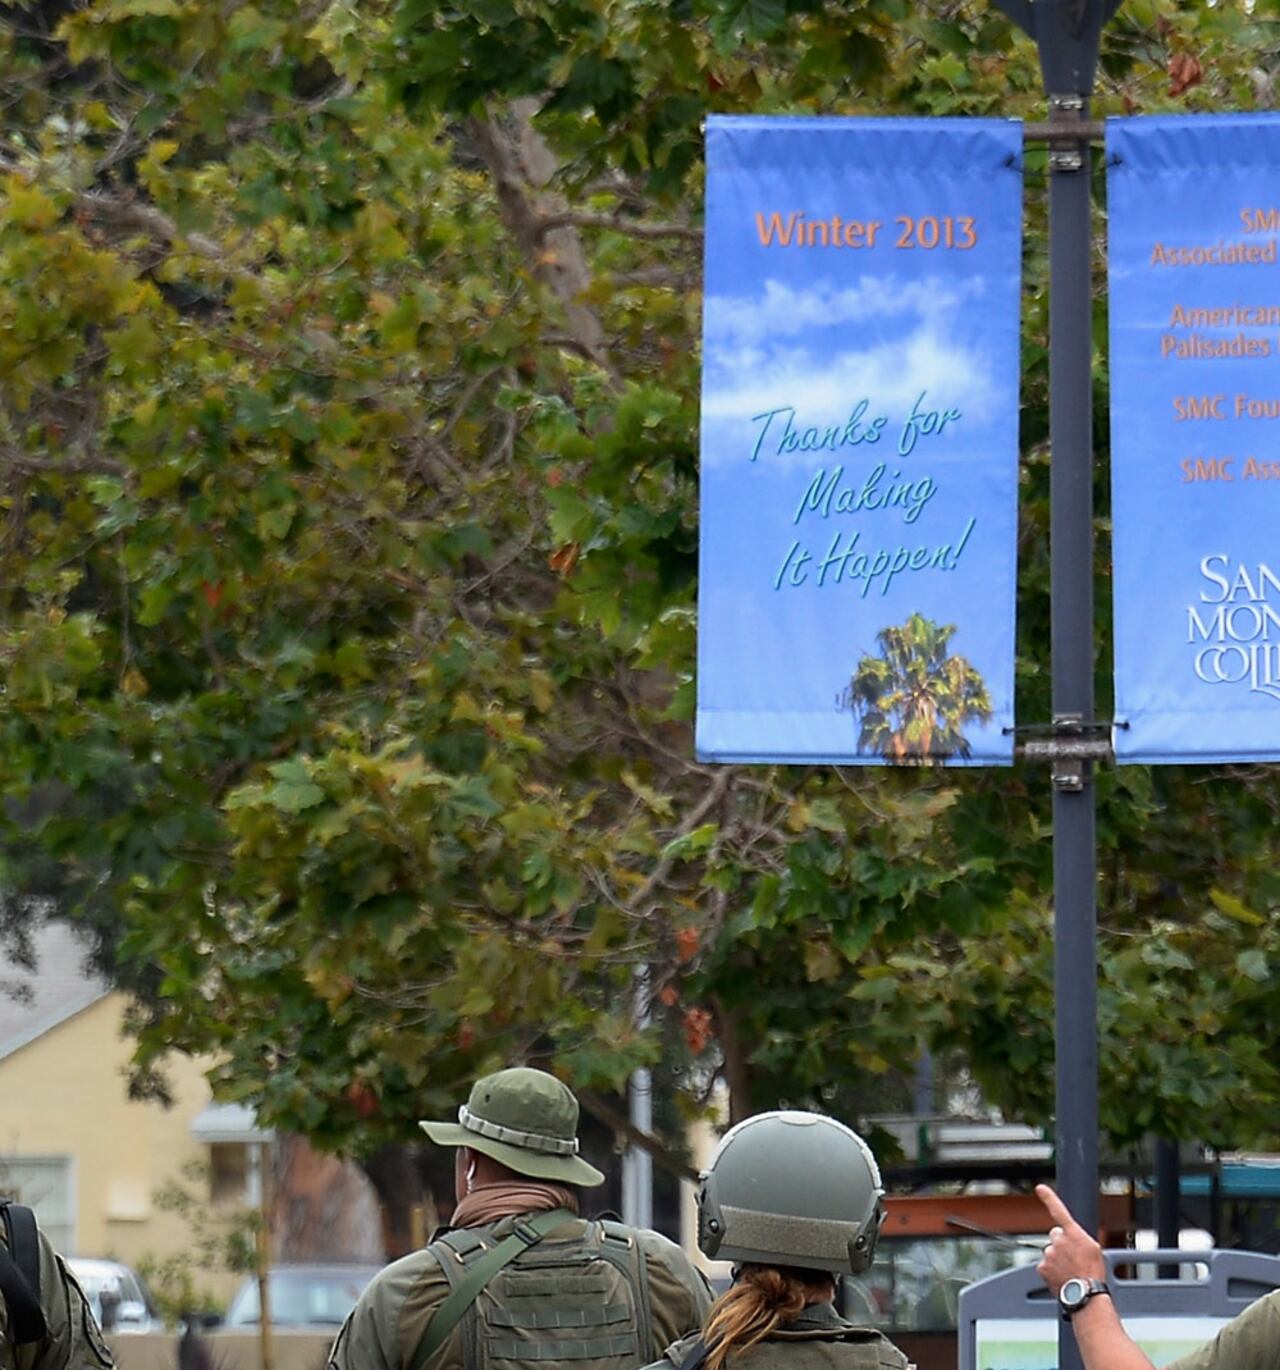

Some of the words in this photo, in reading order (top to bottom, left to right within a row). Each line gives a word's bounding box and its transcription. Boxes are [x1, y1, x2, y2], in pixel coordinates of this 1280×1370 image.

[754, 210, 881, 248] Winter
[895, 214, 978, 249] 2013
[1151, 239, 1277, 267] Associated
[1161, 332, 1270, 359] Palisades
[1173, 395, 1228, 422] SMC
[749, 398, 889, 463] Thanks
[896, 389, 963, 457] for
[1180, 456, 1235, 484] SMC
[793, 462, 939, 525] Making
[773, 539, 813, 592] It
[816, 516, 977, 599] Happen!
